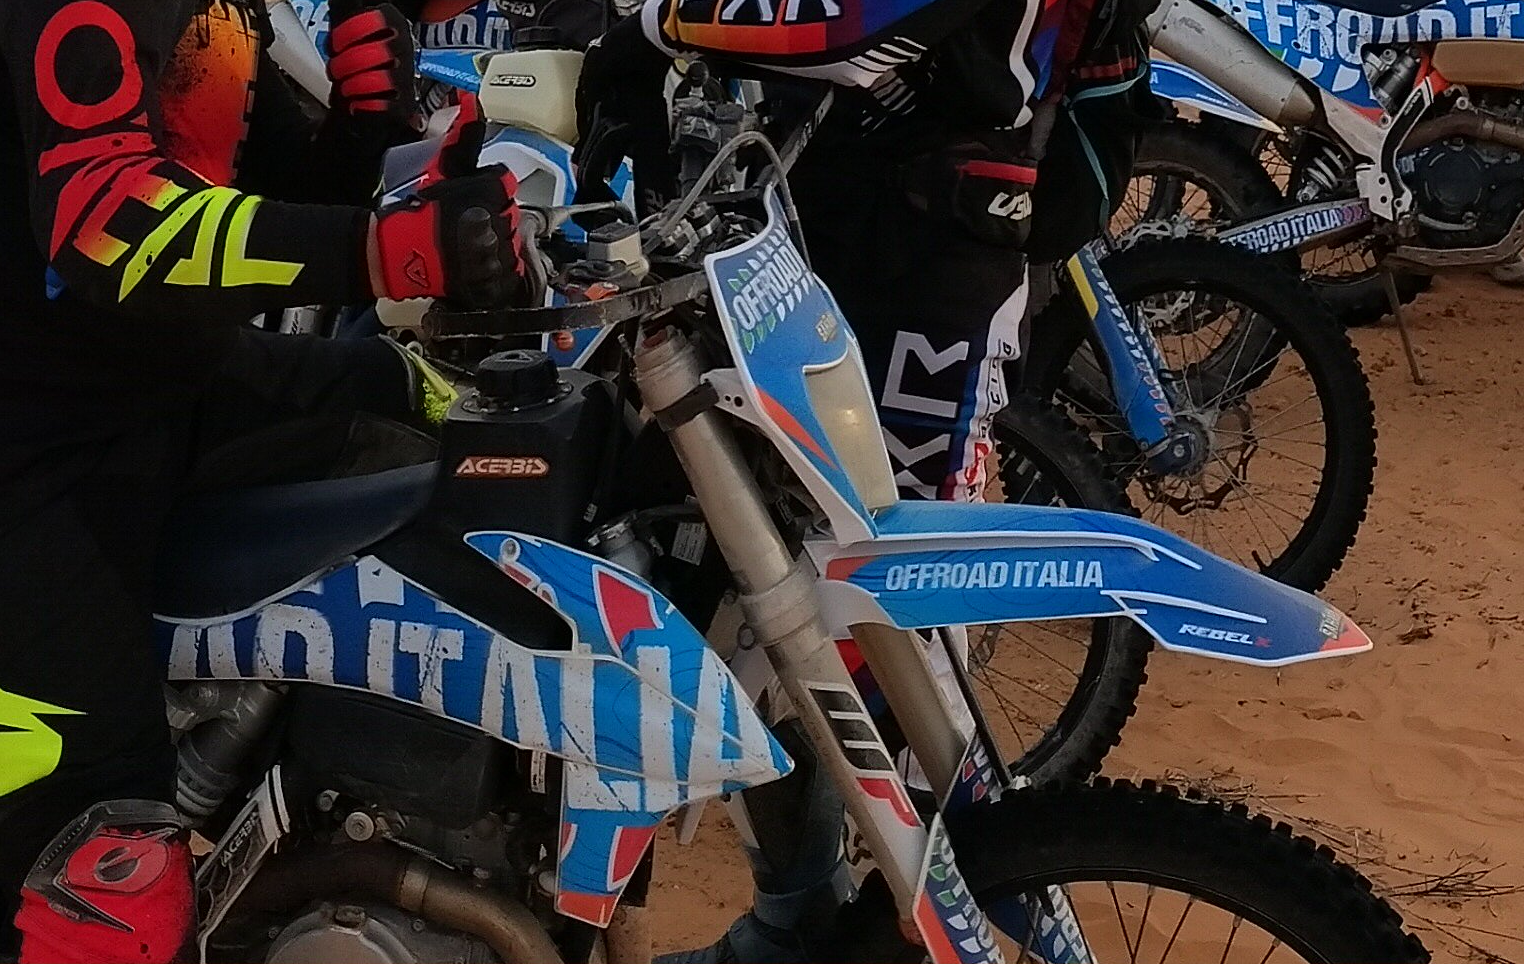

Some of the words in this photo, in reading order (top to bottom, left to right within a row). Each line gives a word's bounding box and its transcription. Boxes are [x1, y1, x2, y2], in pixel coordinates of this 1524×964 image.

[456, 456, 548, 476] ACERBIS
[884, 560, 1010, 592] OFFROAD
[1012, 560, 1104, 589] ITALIA
[1177, 623, 1255, 646] REBEL
